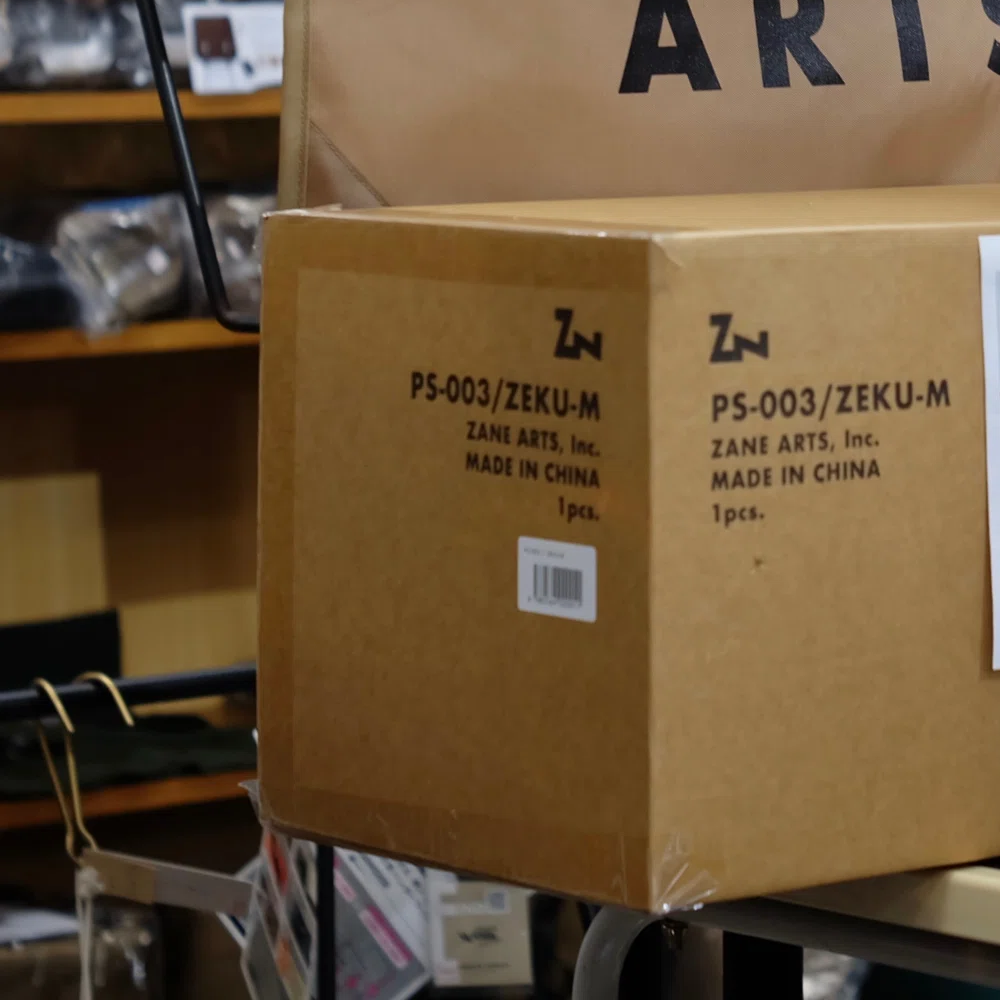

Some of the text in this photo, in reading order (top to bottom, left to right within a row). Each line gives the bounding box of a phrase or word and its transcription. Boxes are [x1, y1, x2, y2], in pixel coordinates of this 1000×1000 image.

[411, 371, 601, 421] PS-003/ZEKU-M
[712, 379, 951, 423] PS-003/ZEKU-M
[467, 420, 600, 457] ZANE ARTS, Inc.
[711, 429, 879, 459] ZANE ARTS, Inc.
[466, 451, 600, 489] MADE IN CHINA
[711, 459, 880, 491] MADE IN CHINA
